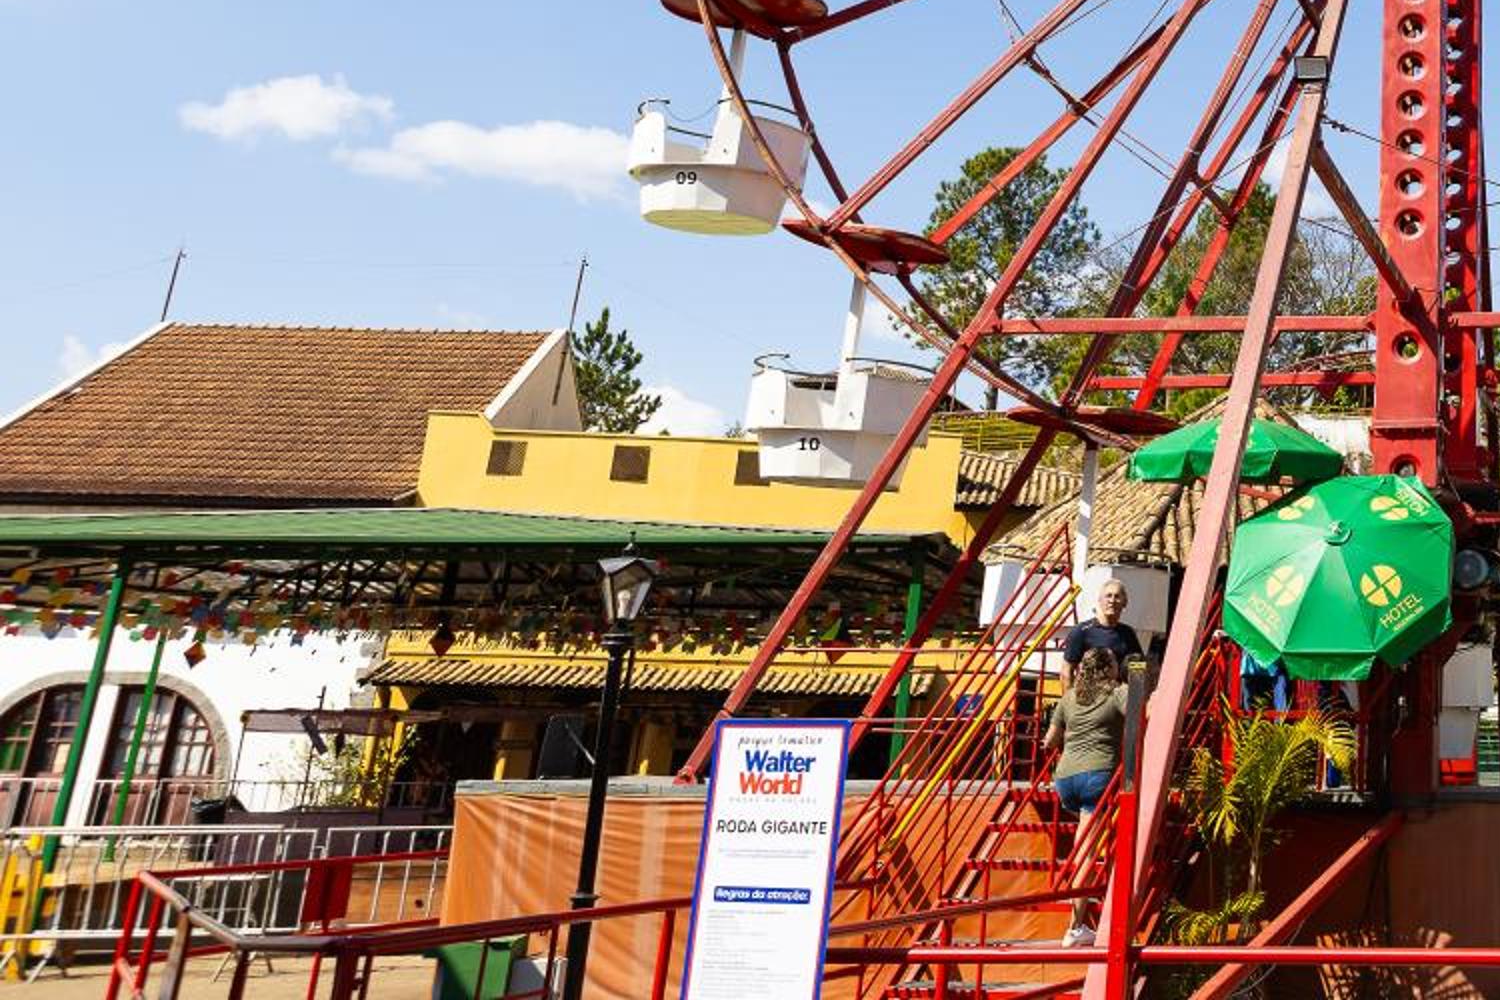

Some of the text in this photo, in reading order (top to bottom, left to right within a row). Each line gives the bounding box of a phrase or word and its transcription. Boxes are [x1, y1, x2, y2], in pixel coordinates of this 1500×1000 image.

[676, 172, 697, 184] 09
[799, 438, 820, 451] 10
[1380, 594, 1423, 629] HOTEL
[745, 750, 816, 773] Walter
[740, 772, 803, 795] World
[716, 819, 827, 835] RODA GIGANTE
